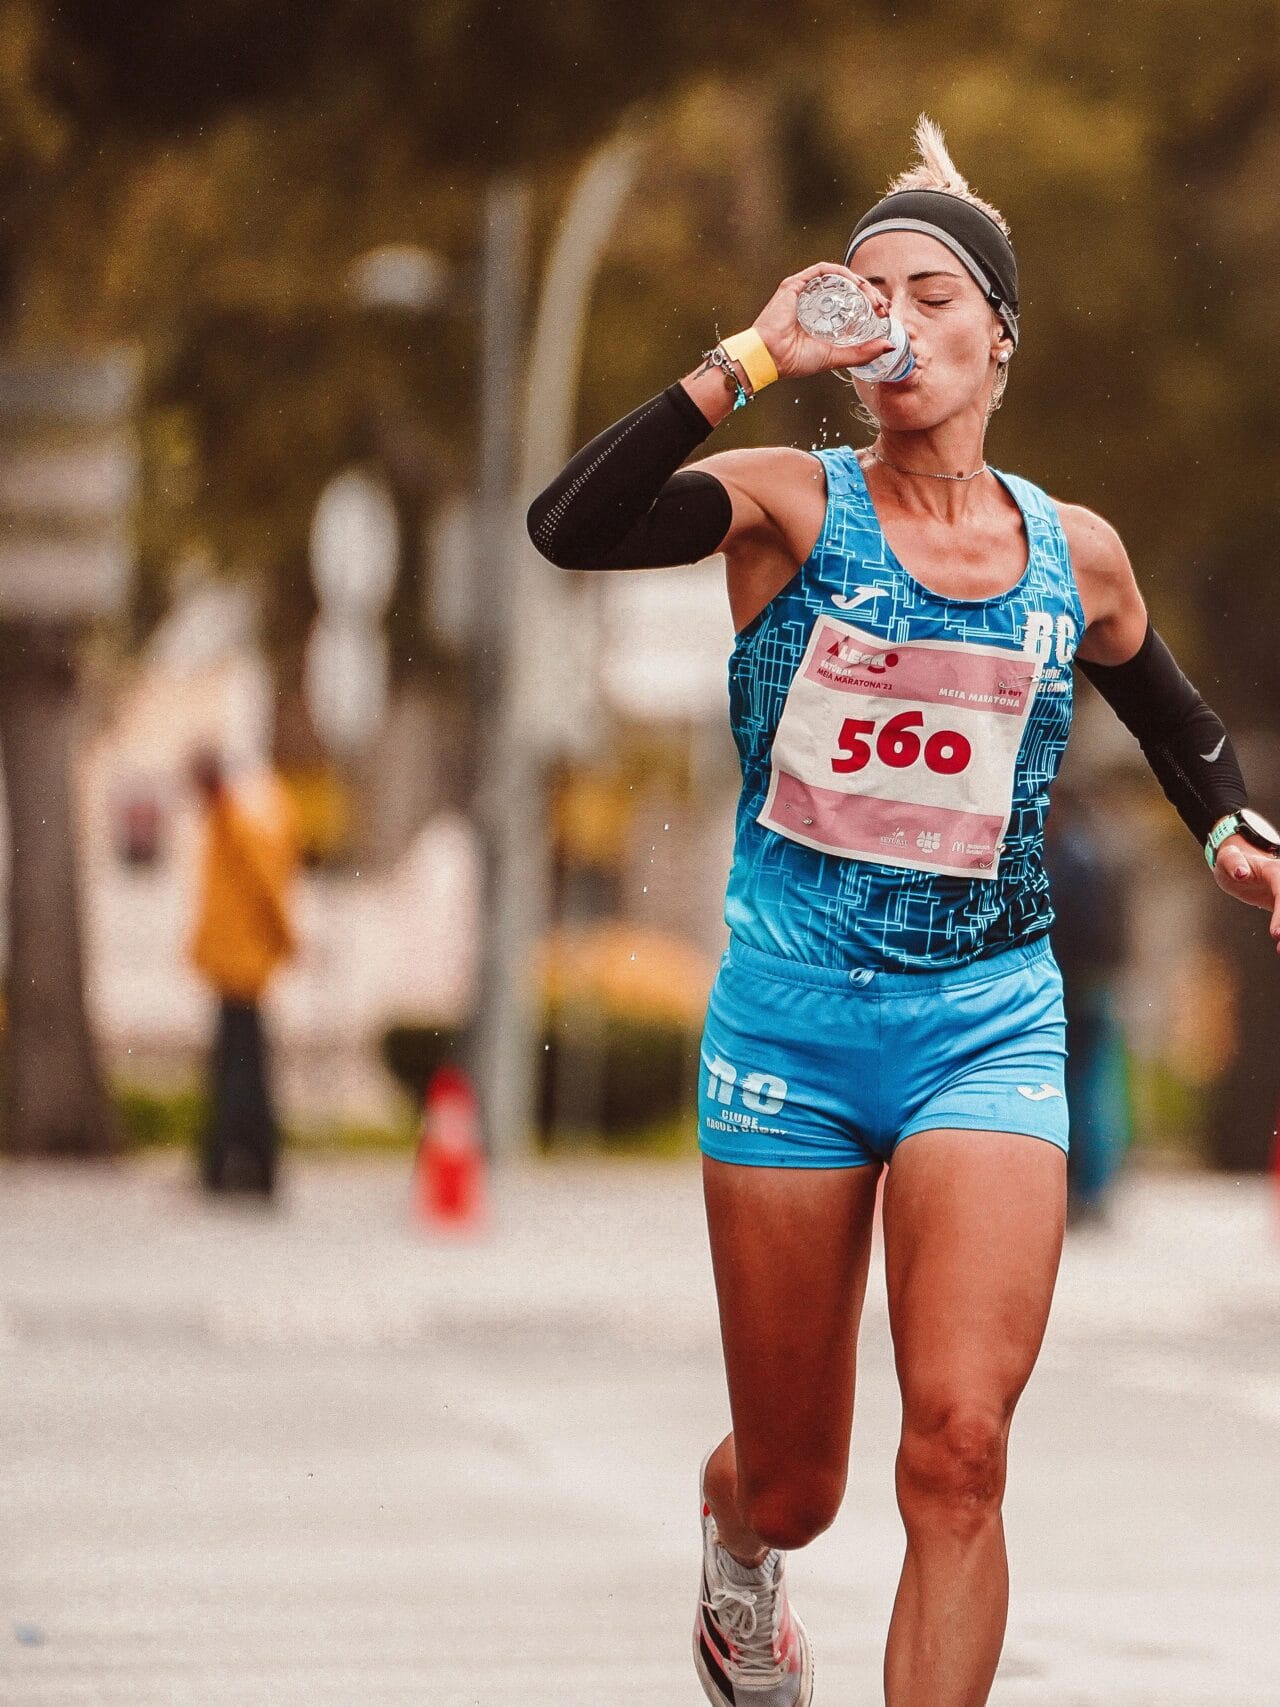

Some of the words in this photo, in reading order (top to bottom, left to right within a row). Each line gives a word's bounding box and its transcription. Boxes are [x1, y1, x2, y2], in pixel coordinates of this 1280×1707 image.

[817, 668, 833, 679] MEIA
[939, 687, 966, 699] MEIA
[968, 693, 1020, 708] MARATONA
[831, 711, 971, 775] 560
